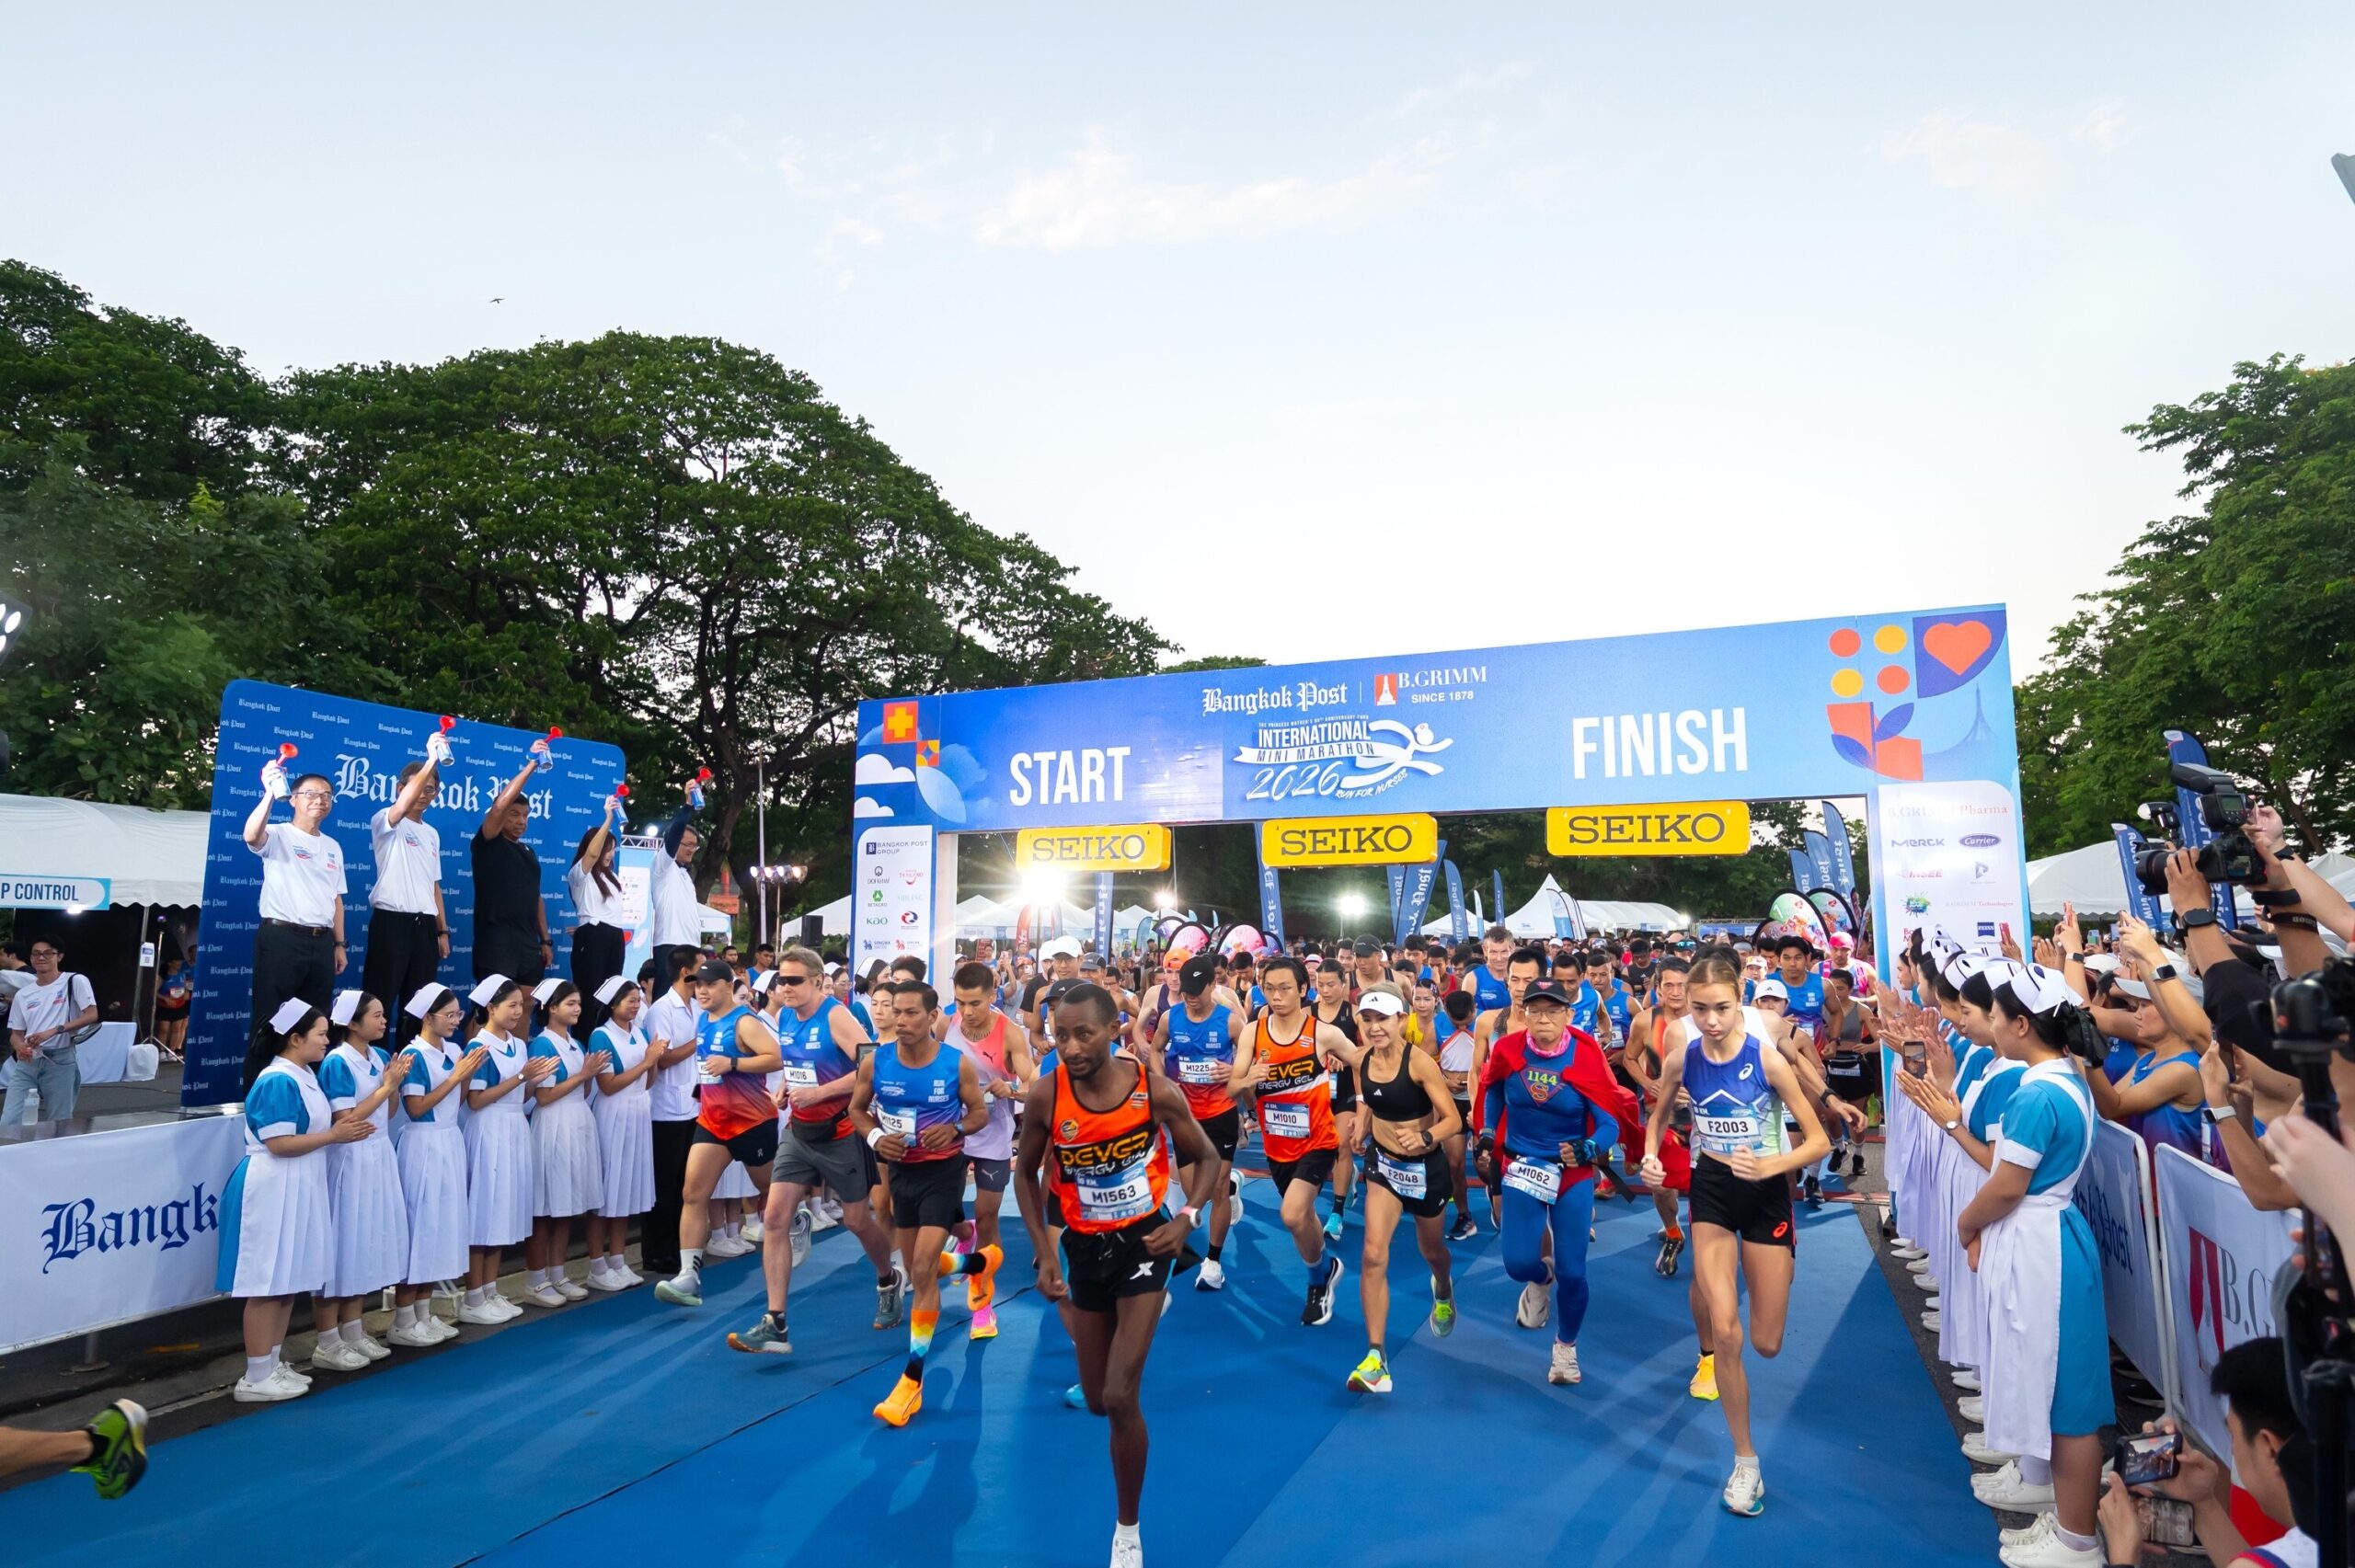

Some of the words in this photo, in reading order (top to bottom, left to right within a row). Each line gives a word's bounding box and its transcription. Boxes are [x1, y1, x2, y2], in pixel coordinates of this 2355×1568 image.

[1397, 666, 1488, 689] B.GRIMM
[1201, 684, 1292, 717] Bangkok
[1297, 681, 1348, 712] Post
[1411, 692, 1446, 704] SINCE
[1449, 690, 1475, 702] 1878
[238, 698, 265, 709] Bangkok
[267, 704, 281, 713] Post
[231, 719, 246, 728] Post
[312, 711, 336, 721] Bangkok
[337, 715, 350, 725] Post
[274, 727, 299, 738] Bangkok
[301, 730, 314, 739] Post
[378, 723, 400, 734] Bangkok
[401, 727, 413, 736] Post
[1258, 720, 1372, 748] INTERNATIONAL
[344, 738, 367, 748] Bangkok
[368, 741, 381, 750] Post
[460, 737, 470, 745] Post
[494, 742, 512, 751] Bangkok
[1572, 706, 1748, 780] FINISH
[234, 742, 260, 753] Bangkok
[262, 744, 276, 755] Post
[1257, 750, 1288, 762] MINI
[1296, 742, 1375, 761] MARATHON
[226, 763, 242, 773] Post
[465, 756, 485, 766] Bangkok
[486, 759, 497, 767] Post
[334, 753, 480, 812] Bankok
[1009, 746, 1132, 807] START
[1246, 761, 1344, 801] 2026
[1335, 789, 1354, 799] RUN
[1355, 787, 1373, 797] FOR
[1375, 768, 1408, 795] NURSES
[230, 786, 257, 797] Bangkok
[222, 808, 237, 818] Post
[1960, 804, 2008, 815] Pharma
[337, 818, 361, 830] Bangkok
[1568, 812, 1726, 844] SEIKO
[1280, 824, 1413, 856] SEIKO
[1964, 837, 1995, 845] Carrier
[1031, 833, 1146, 863] SEIKO
[217, 853, 232, 863] Post
[221, 876, 247, 886] Bangkok
[1411, 867, 1433, 907] Post
[15, 884, 79, 901] CONTROL
[213, 898, 227, 907] Post
[215, 921, 243, 931] Bangkok
[207, 944, 223, 953] Post
[211, 966, 238, 976] Bangkok
[202, 990, 218, 999] Post
[206, 1012, 235, 1021] Bangkok
[236, 1012, 250, 1020] Post
[198, 1036, 213, 1045] Post
[201, 1057, 230, 1067] Bangkok
[1186, 1064, 1210, 1072] M1225
[789, 1070, 808, 1081] M1016
[1267, 1059, 1315, 1081] EVER
[1258, 1078, 1291, 1090] ENERGY
[1293, 1074, 1314, 1085] GEL
[1527, 1070, 1557, 1085] 1144
[193, 1082, 208, 1091] Post
[1273, 1112, 1297, 1124] M1010
[1707, 1120, 1749, 1133] F2003
[1388, 1169, 1419, 1184] F2048
[1518, 1166, 1550, 1185] M1062
[1092, 1185, 1136, 1204] M1563
[40, 1182, 220, 1275] Bangk
